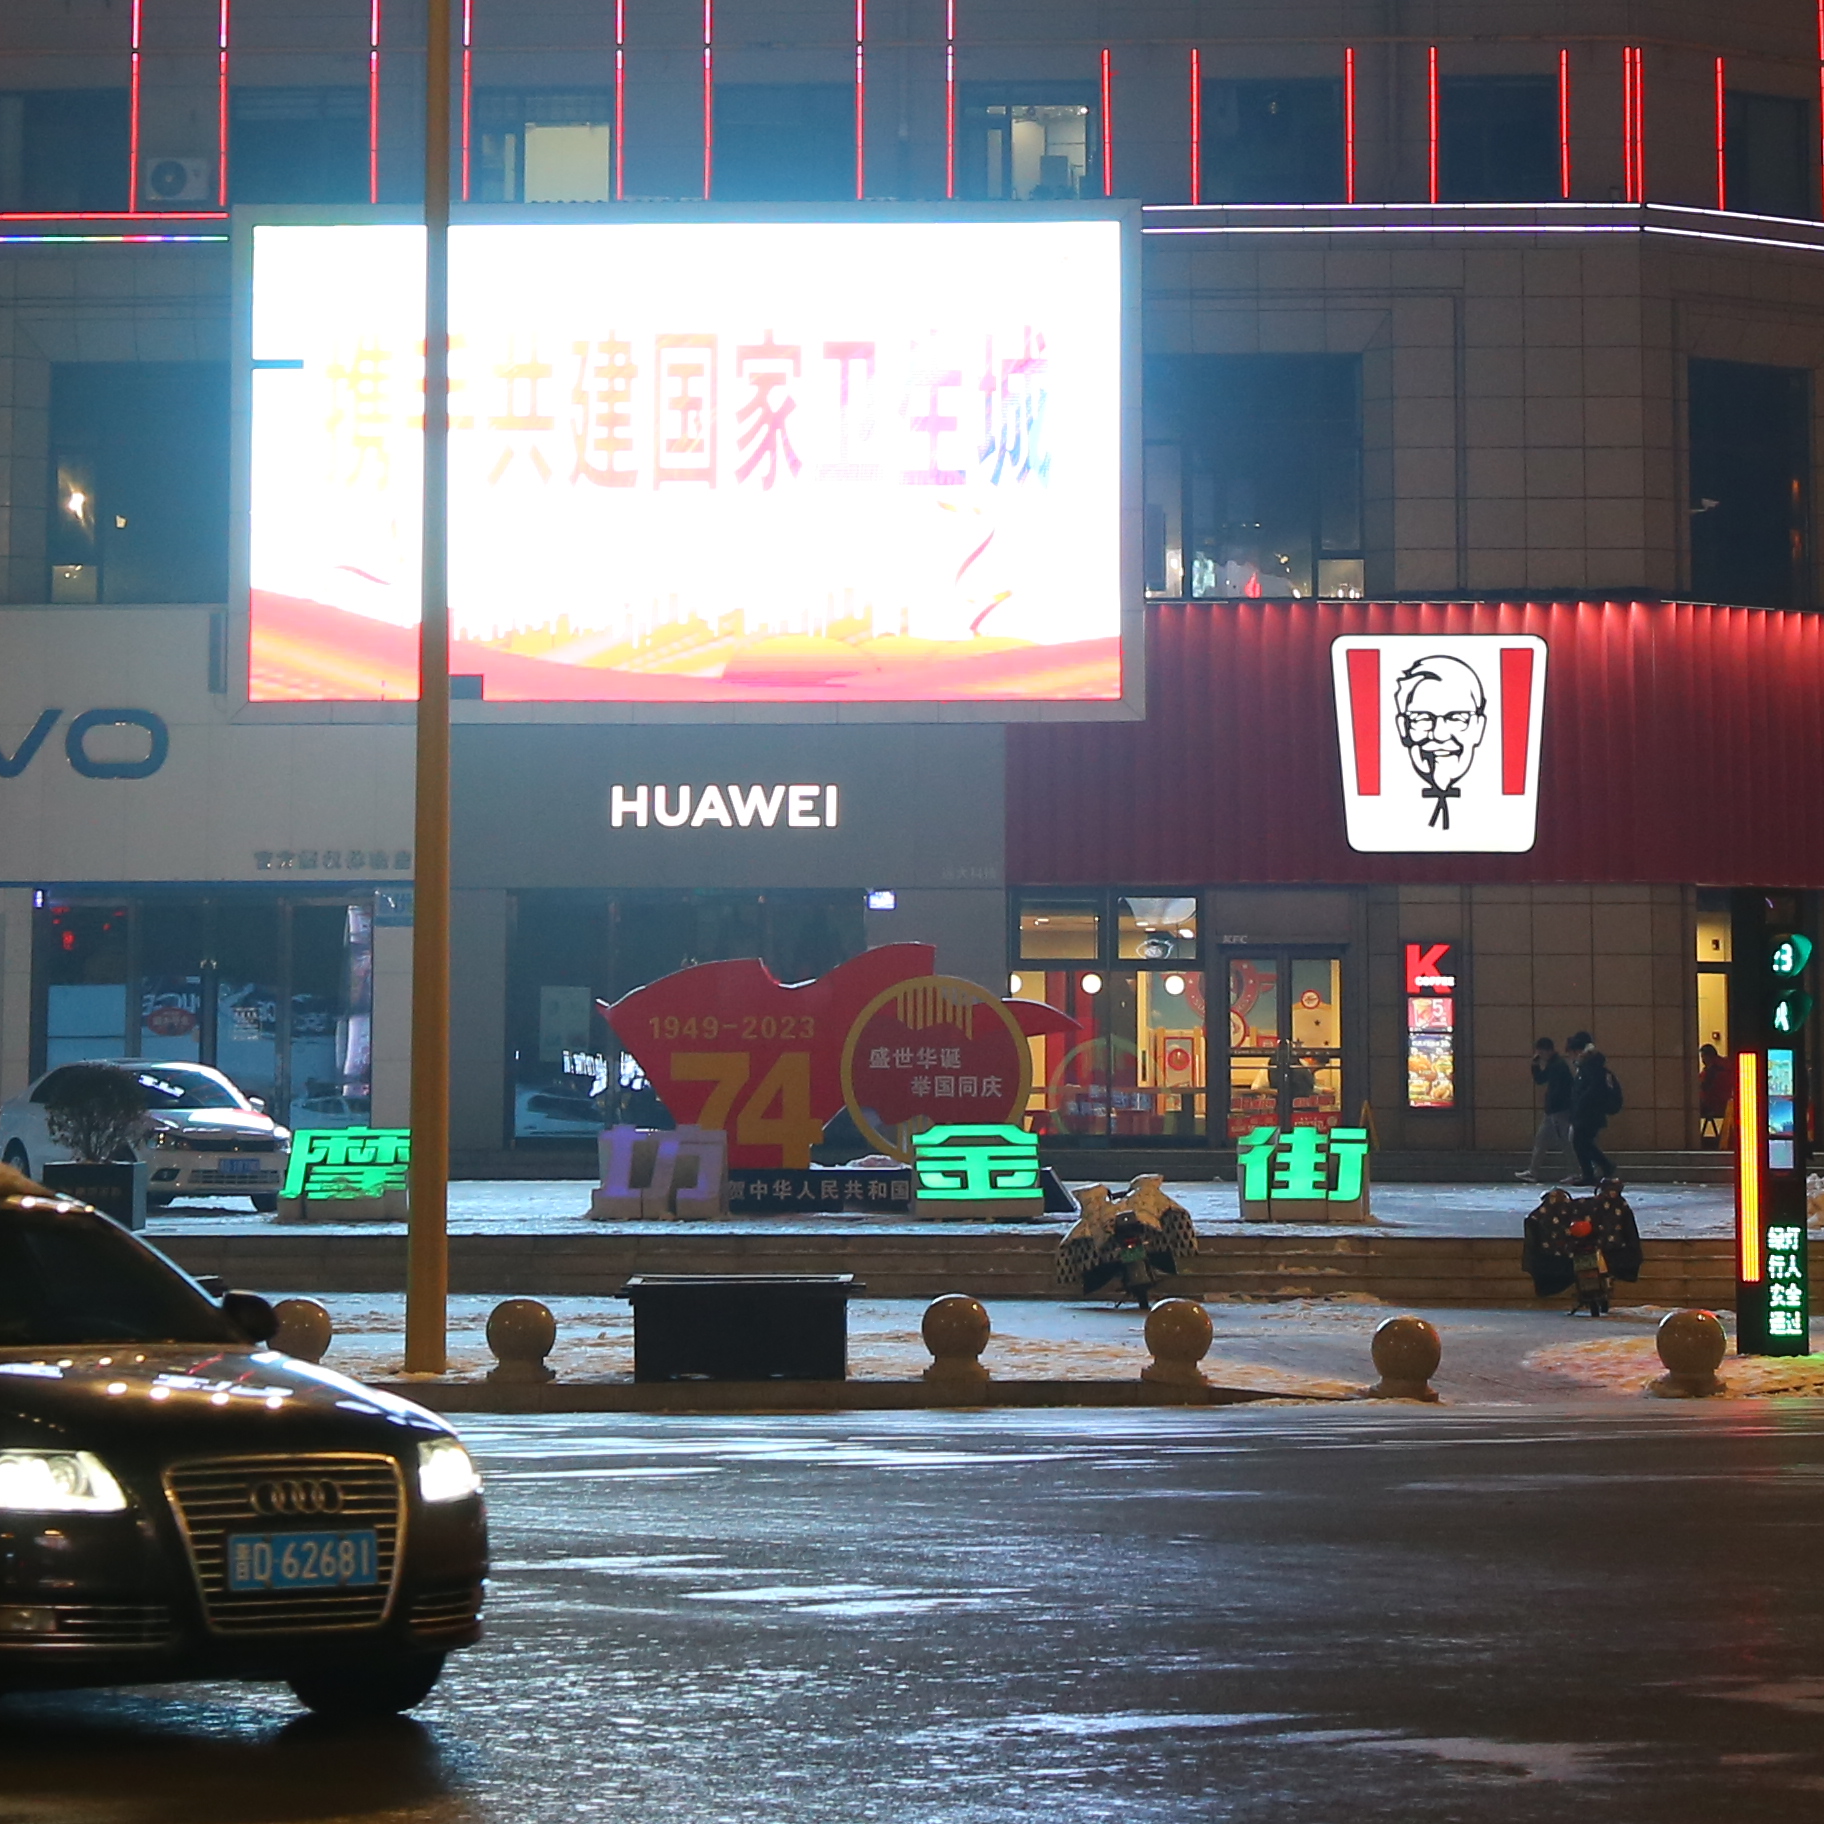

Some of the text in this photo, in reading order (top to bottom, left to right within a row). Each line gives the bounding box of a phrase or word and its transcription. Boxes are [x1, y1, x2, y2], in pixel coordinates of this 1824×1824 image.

[610, 784, 840, 828] HUAWEI
[648, 1015, 816, 1041] 1949-2023
[869, 1047, 962, 1070] 盛世华诞
[910, 1074, 1003, 1098] 举国同庆
[670, 1051, 824, 1169] 74
[277, 1125, 412, 1200] 摩
[911, 1123, 1045, 1200] 金
[1237, 1126, 1369, 1202] 街
[1766, 1253, 1803, 1280] 行人
[1768, 1282, 1803, 1308] 安全
